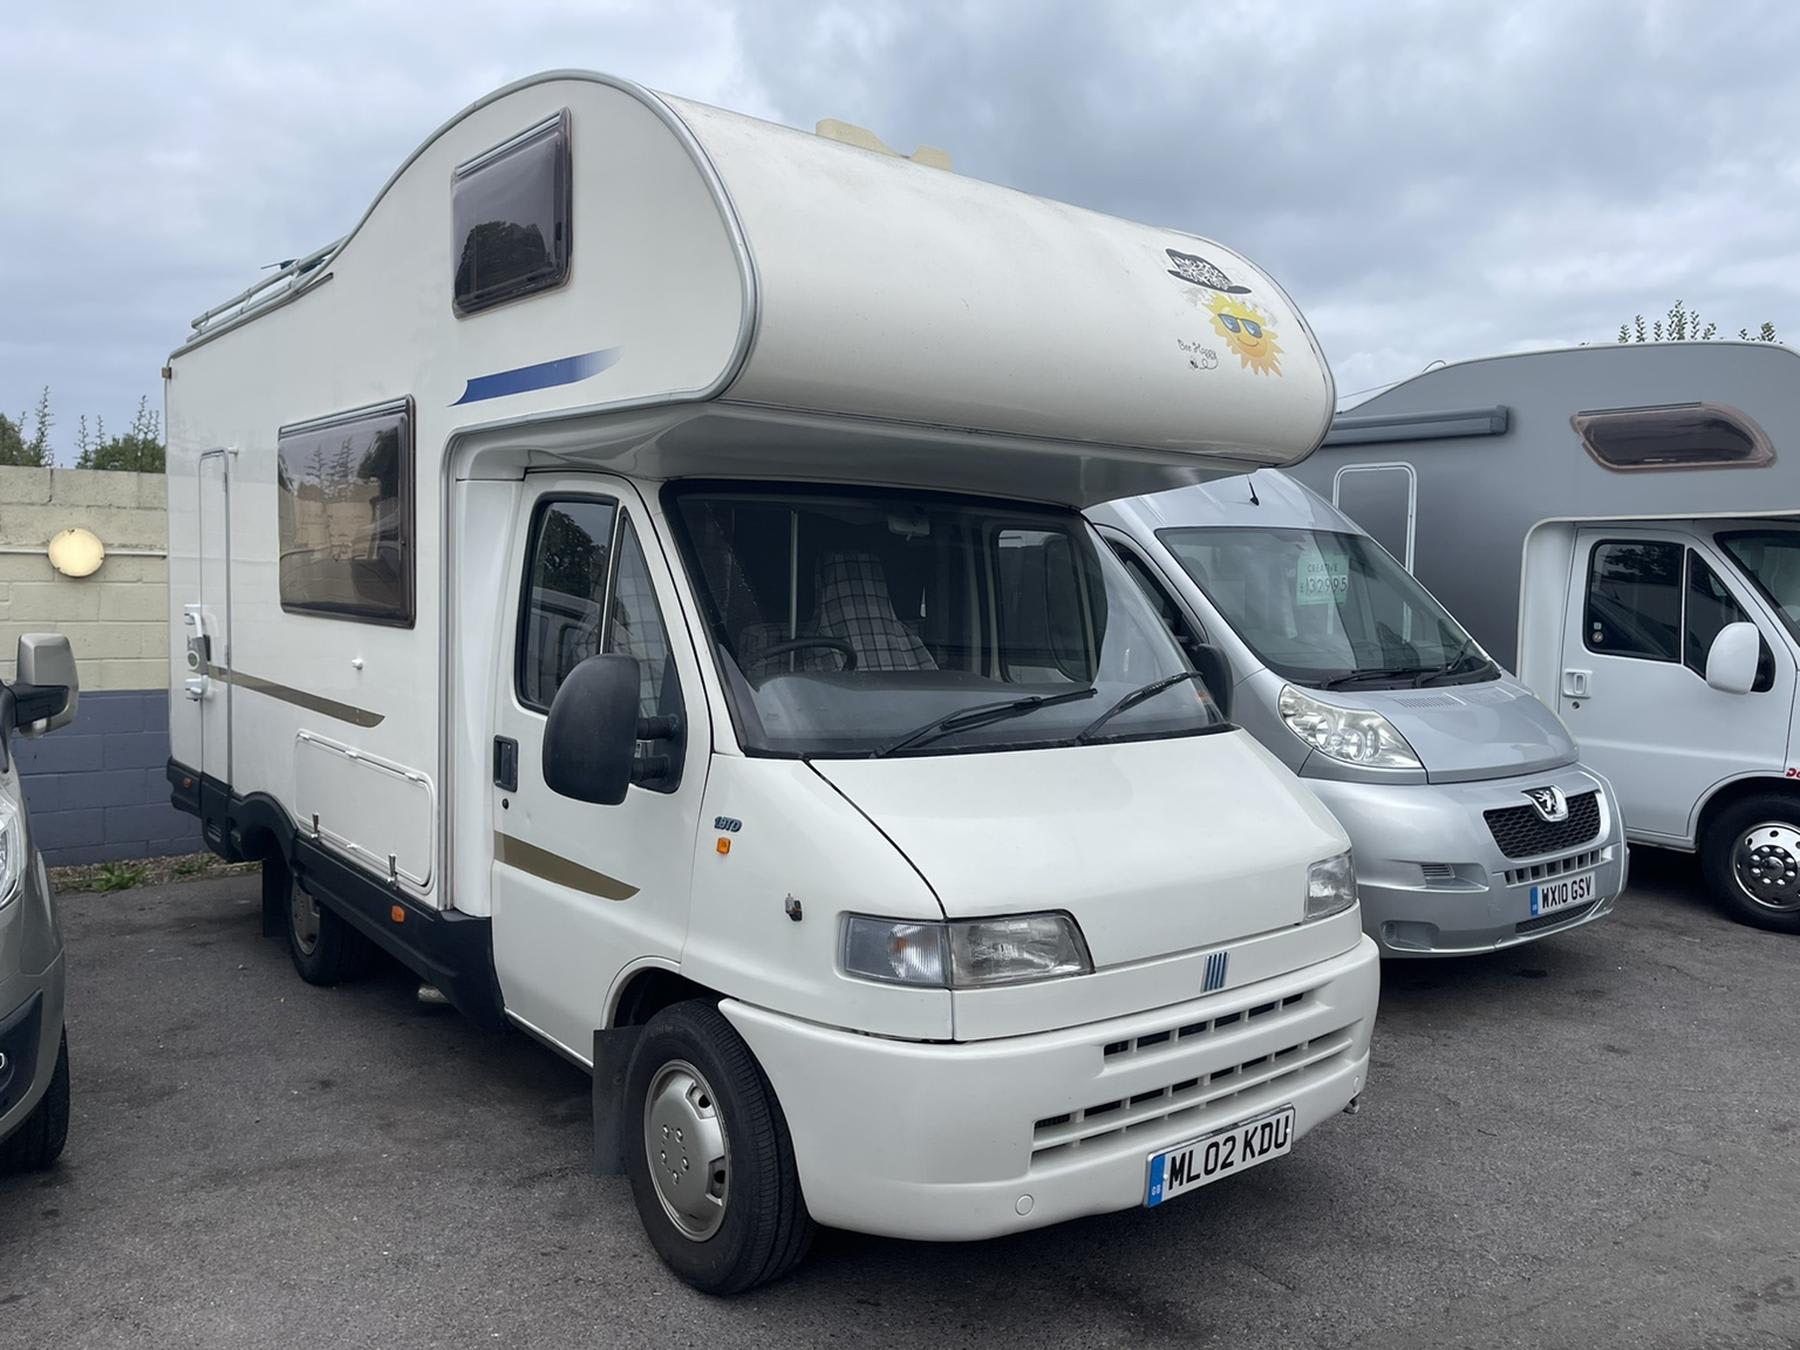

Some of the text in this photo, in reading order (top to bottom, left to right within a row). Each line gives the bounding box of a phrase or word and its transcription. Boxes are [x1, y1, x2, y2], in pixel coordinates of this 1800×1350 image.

[1541, 876, 1592, 909] WX10 GSV
[1168, 1115, 1290, 1190] ML02 KDU
